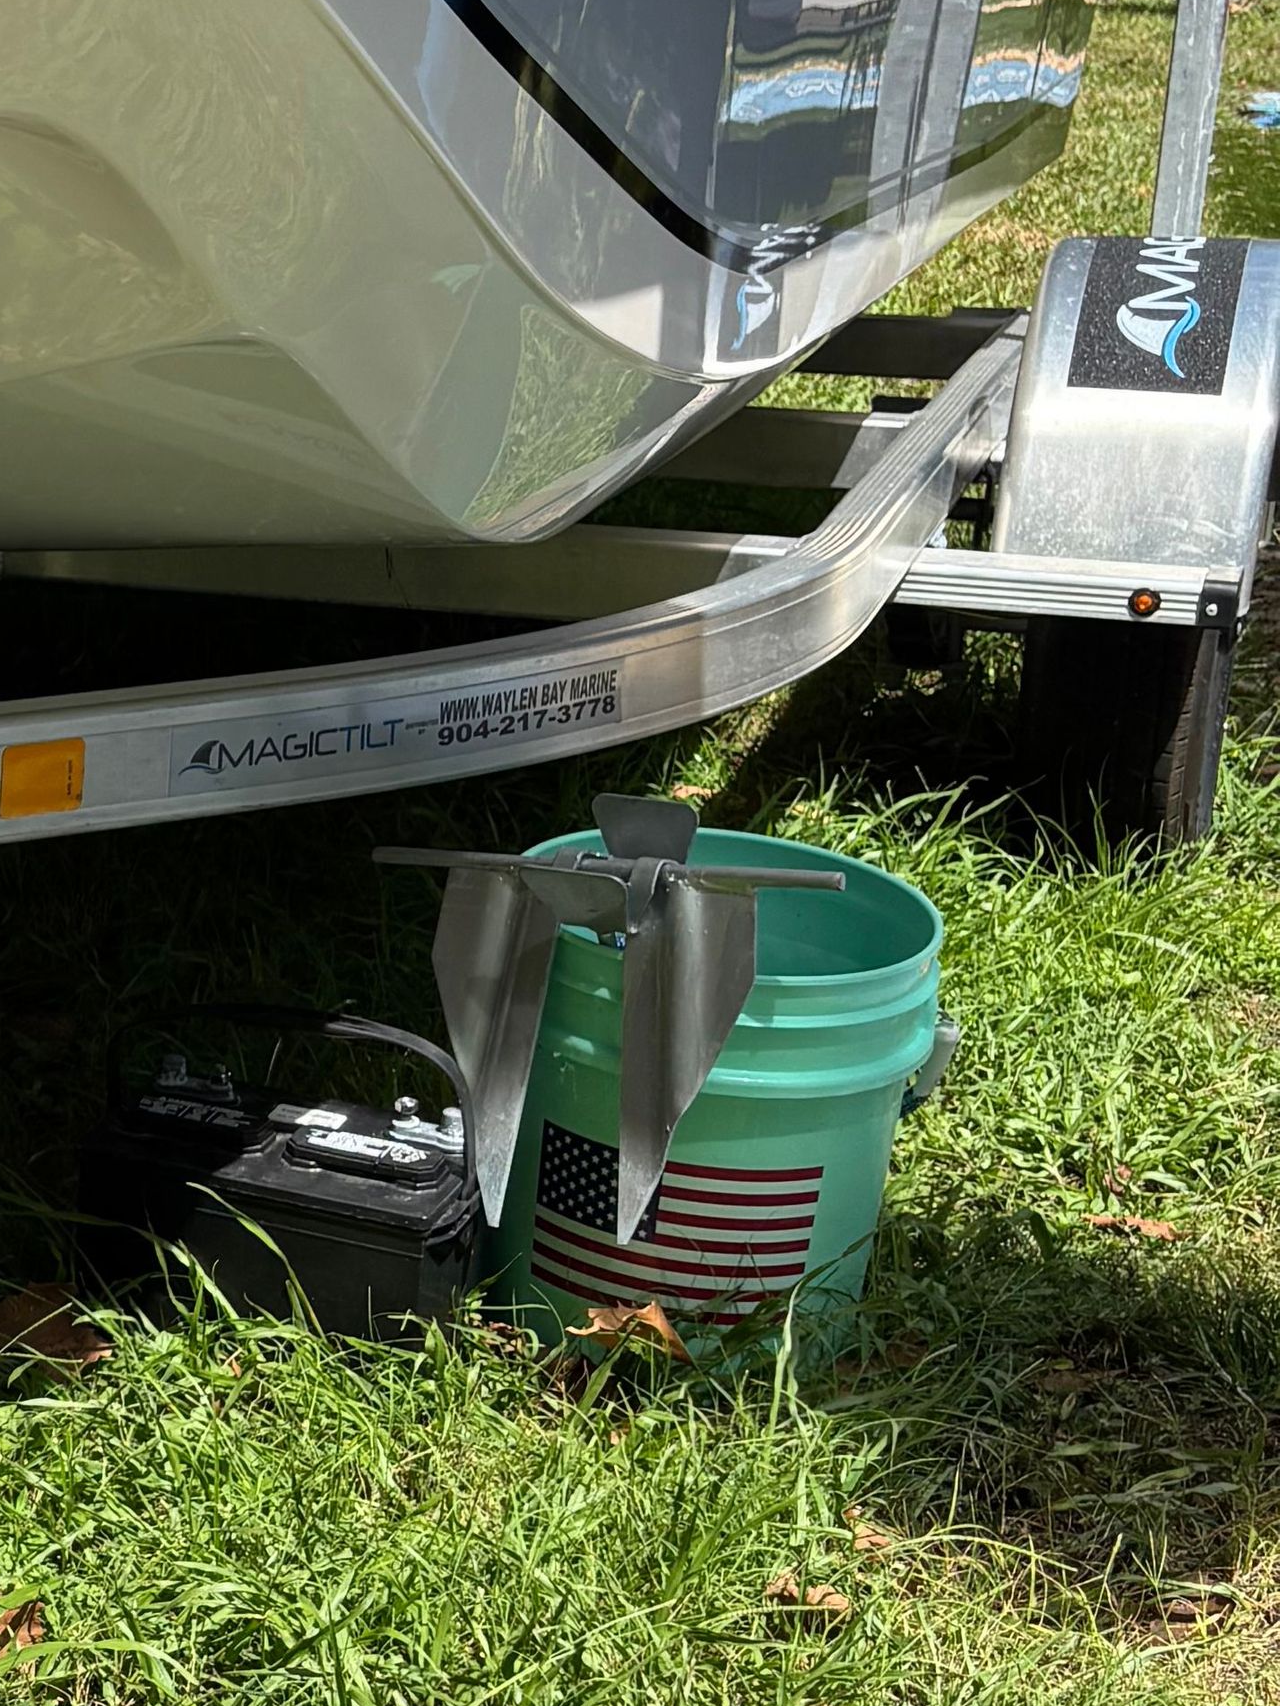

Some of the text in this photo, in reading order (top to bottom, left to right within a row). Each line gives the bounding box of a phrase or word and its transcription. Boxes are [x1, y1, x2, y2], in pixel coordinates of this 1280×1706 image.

[437, 694, 616, 746] 904-217-3778
[440, 668, 618, 725] WWW.WAYLEN BAY MARINE
[217, 718, 404, 770] MAGICTILT
